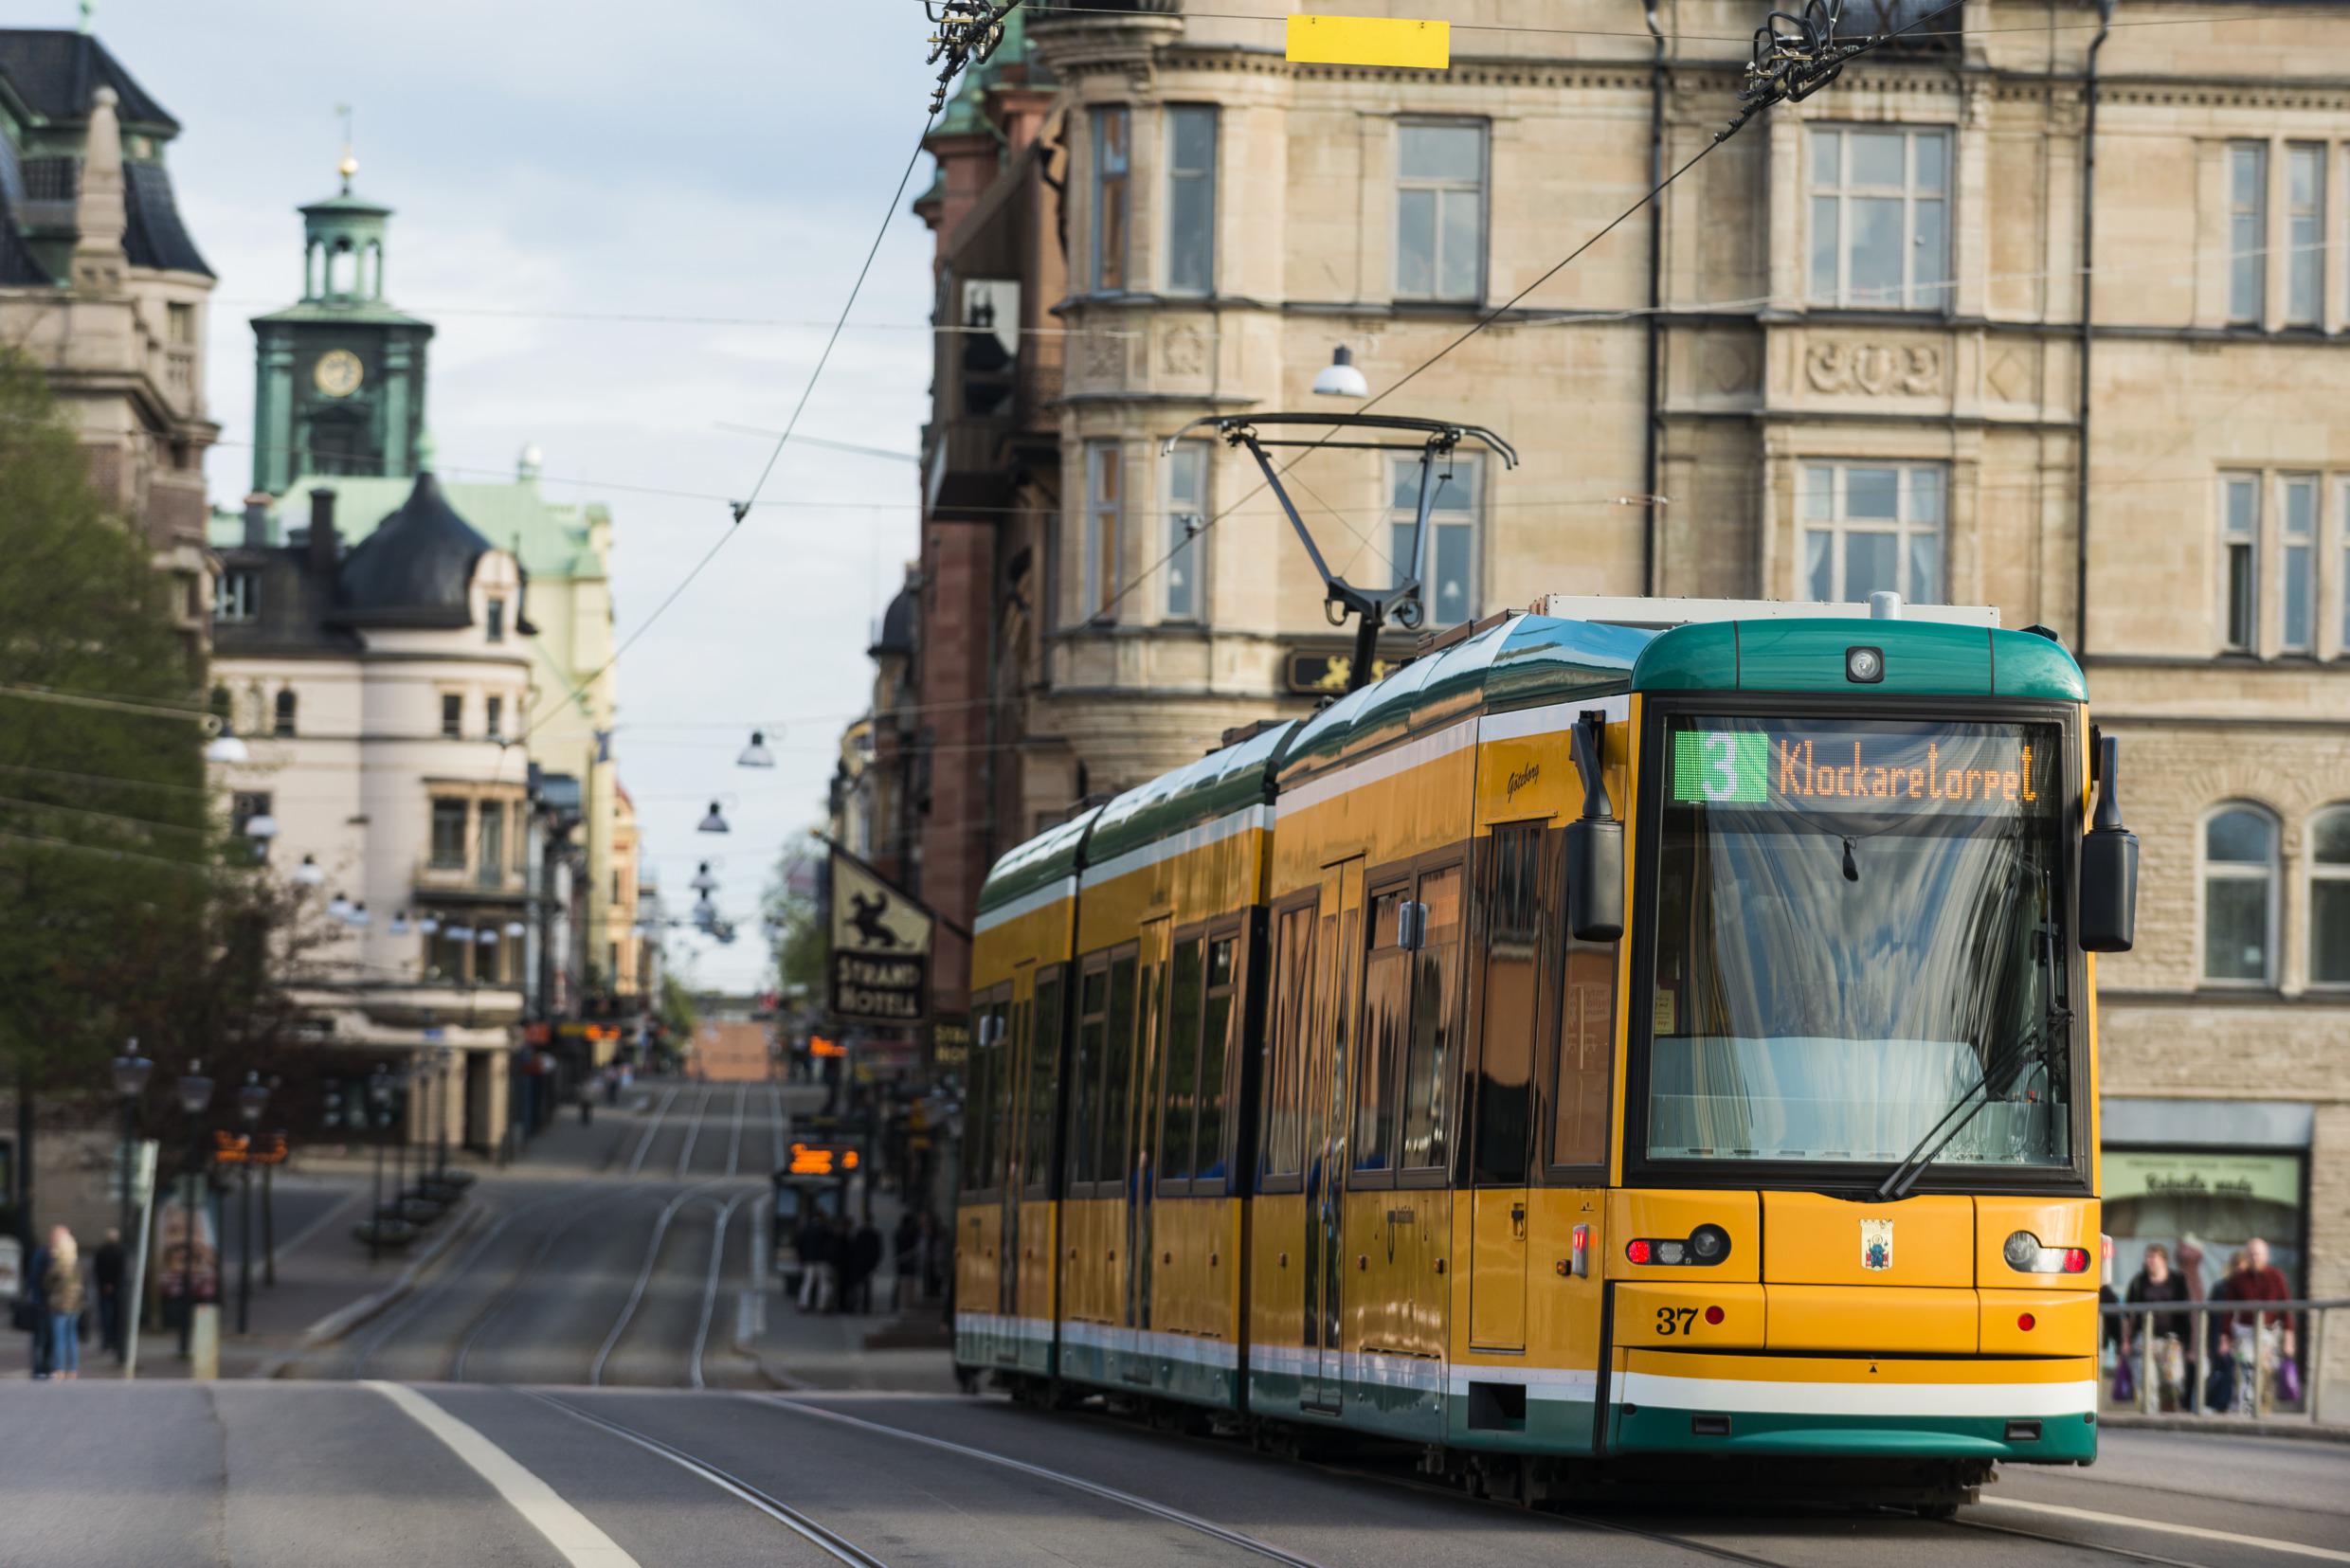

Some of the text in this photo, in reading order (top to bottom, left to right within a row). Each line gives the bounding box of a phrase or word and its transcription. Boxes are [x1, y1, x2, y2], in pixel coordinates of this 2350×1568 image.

[1508, 762, 1540, 803] Göteborg
[1703, 732, 2036, 802] 3 Klockaretorpet
[1656, 1307, 1699, 1336] 37
